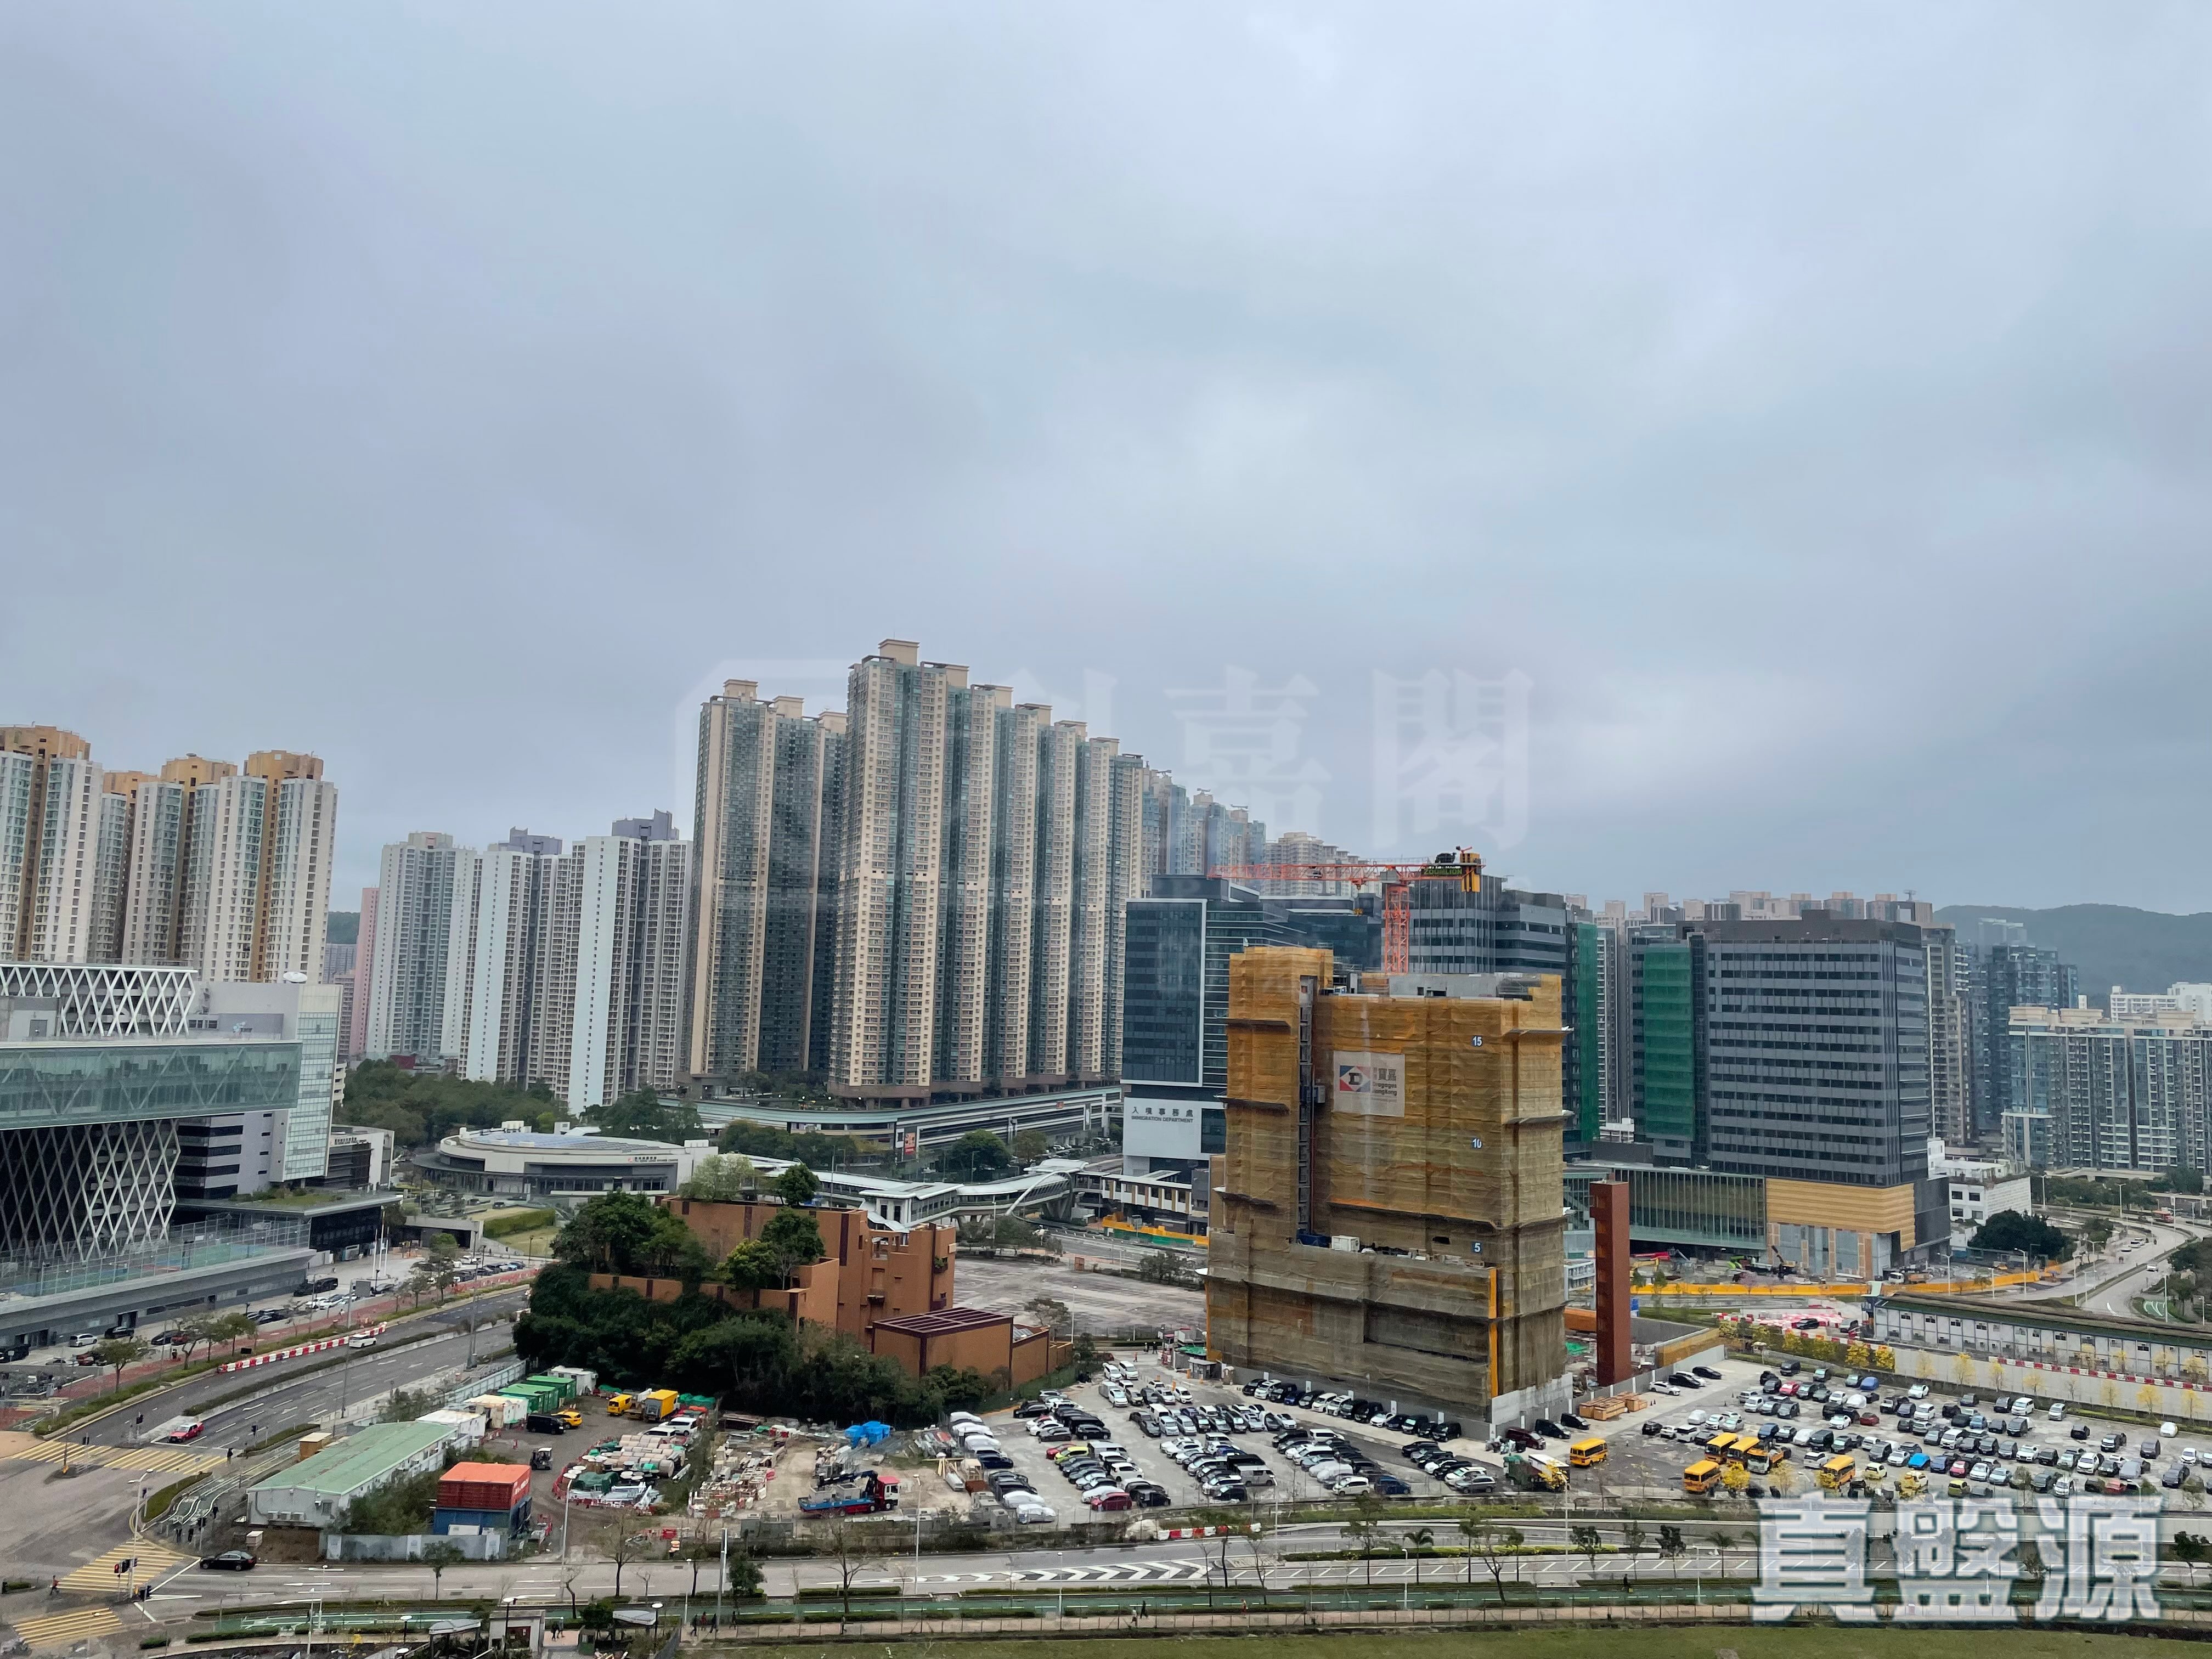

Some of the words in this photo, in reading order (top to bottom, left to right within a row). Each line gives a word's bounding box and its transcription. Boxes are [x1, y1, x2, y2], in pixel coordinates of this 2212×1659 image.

[1472, 1037, 1482, 1047] 15
[1472, 1138, 1482, 1148] 10
[1474, 1243, 1481, 1253] 5
